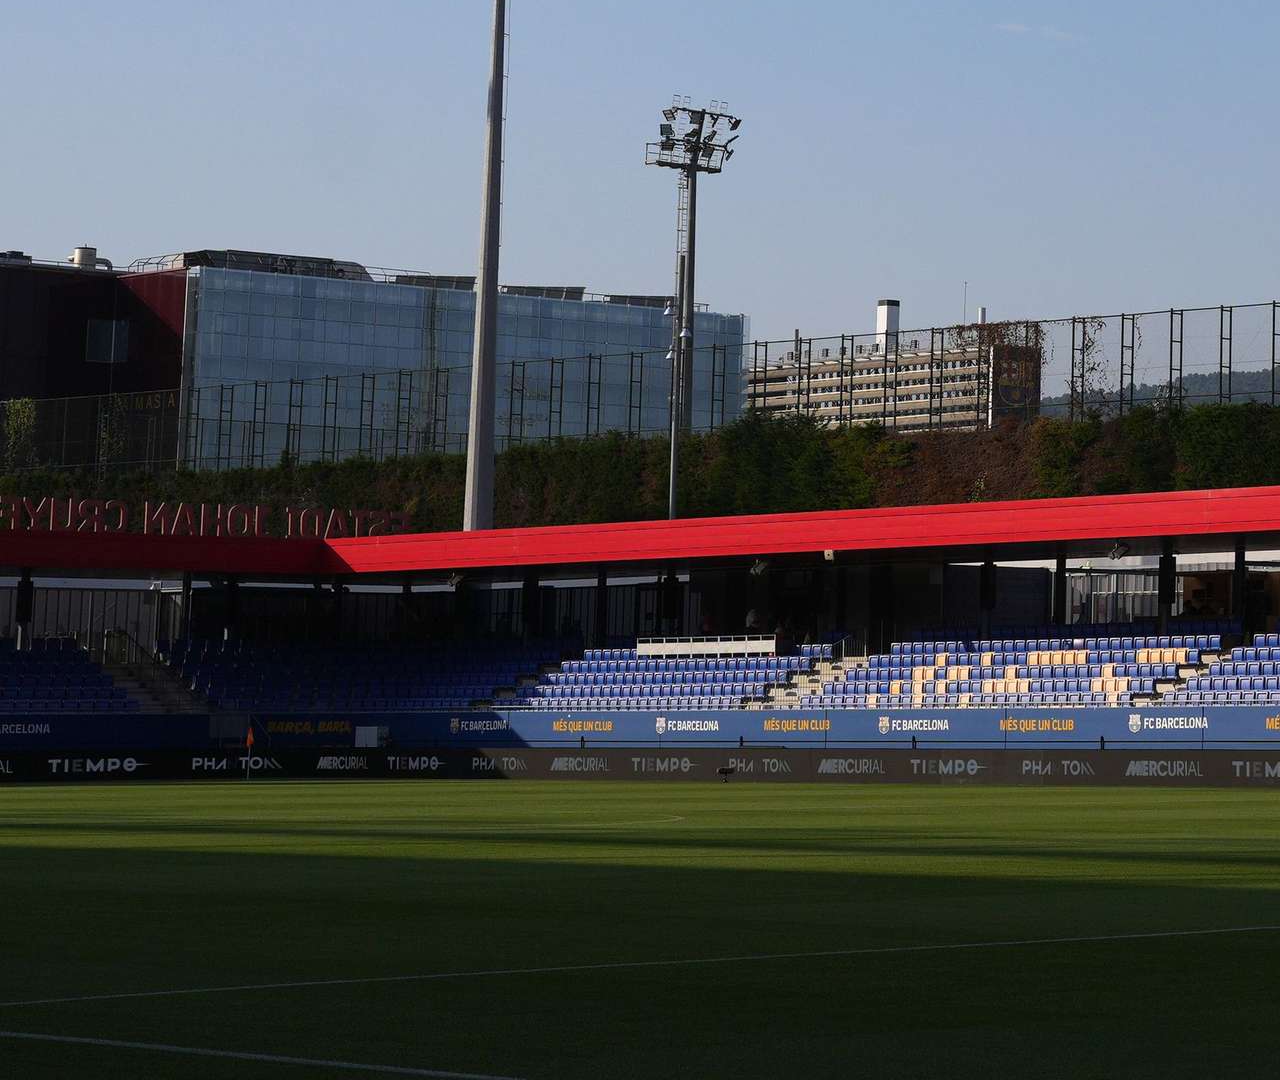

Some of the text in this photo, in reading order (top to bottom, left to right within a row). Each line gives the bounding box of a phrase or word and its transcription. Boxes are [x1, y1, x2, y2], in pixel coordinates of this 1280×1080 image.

[135, 392, 176, 408] MASA
[0, 723, 51, 735] RCELONA
[460, 720, 507, 731] FC BARCELONA
[553, 718, 613, 733] MÉS QUE UN CLUB
[668, 720, 719, 731] FC BARCELONA
[764, 718, 830, 732] MÉS QUE UN CLUB
[892, 720, 949, 730] FC BARCELONA
[1000, 717, 1074, 732] MÉS QUE UN CLUB
[1143, 717, 1208, 729] FC BARCELONA
[48, 757, 152, 772] TIEMPO
[192, 756, 282, 770] PHATOM
[316, 756, 369, 770] MERCURIAL
[388, 756, 447, 771] TIEMPO
[472, 757, 528, 771] PHATOM
[551, 757, 609, 772] MERCURIAL
[632, 757, 700, 772] TIEMPO
[728, 757, 792, 773] PHATOM
[817, 758, 886, 774] MERCURIAL
[911, 759, 987, 776] TIEMPO
[1022, 759, 1096, 776] PHATOM
[1125, 760, 1203, 777] MERCURIAL
